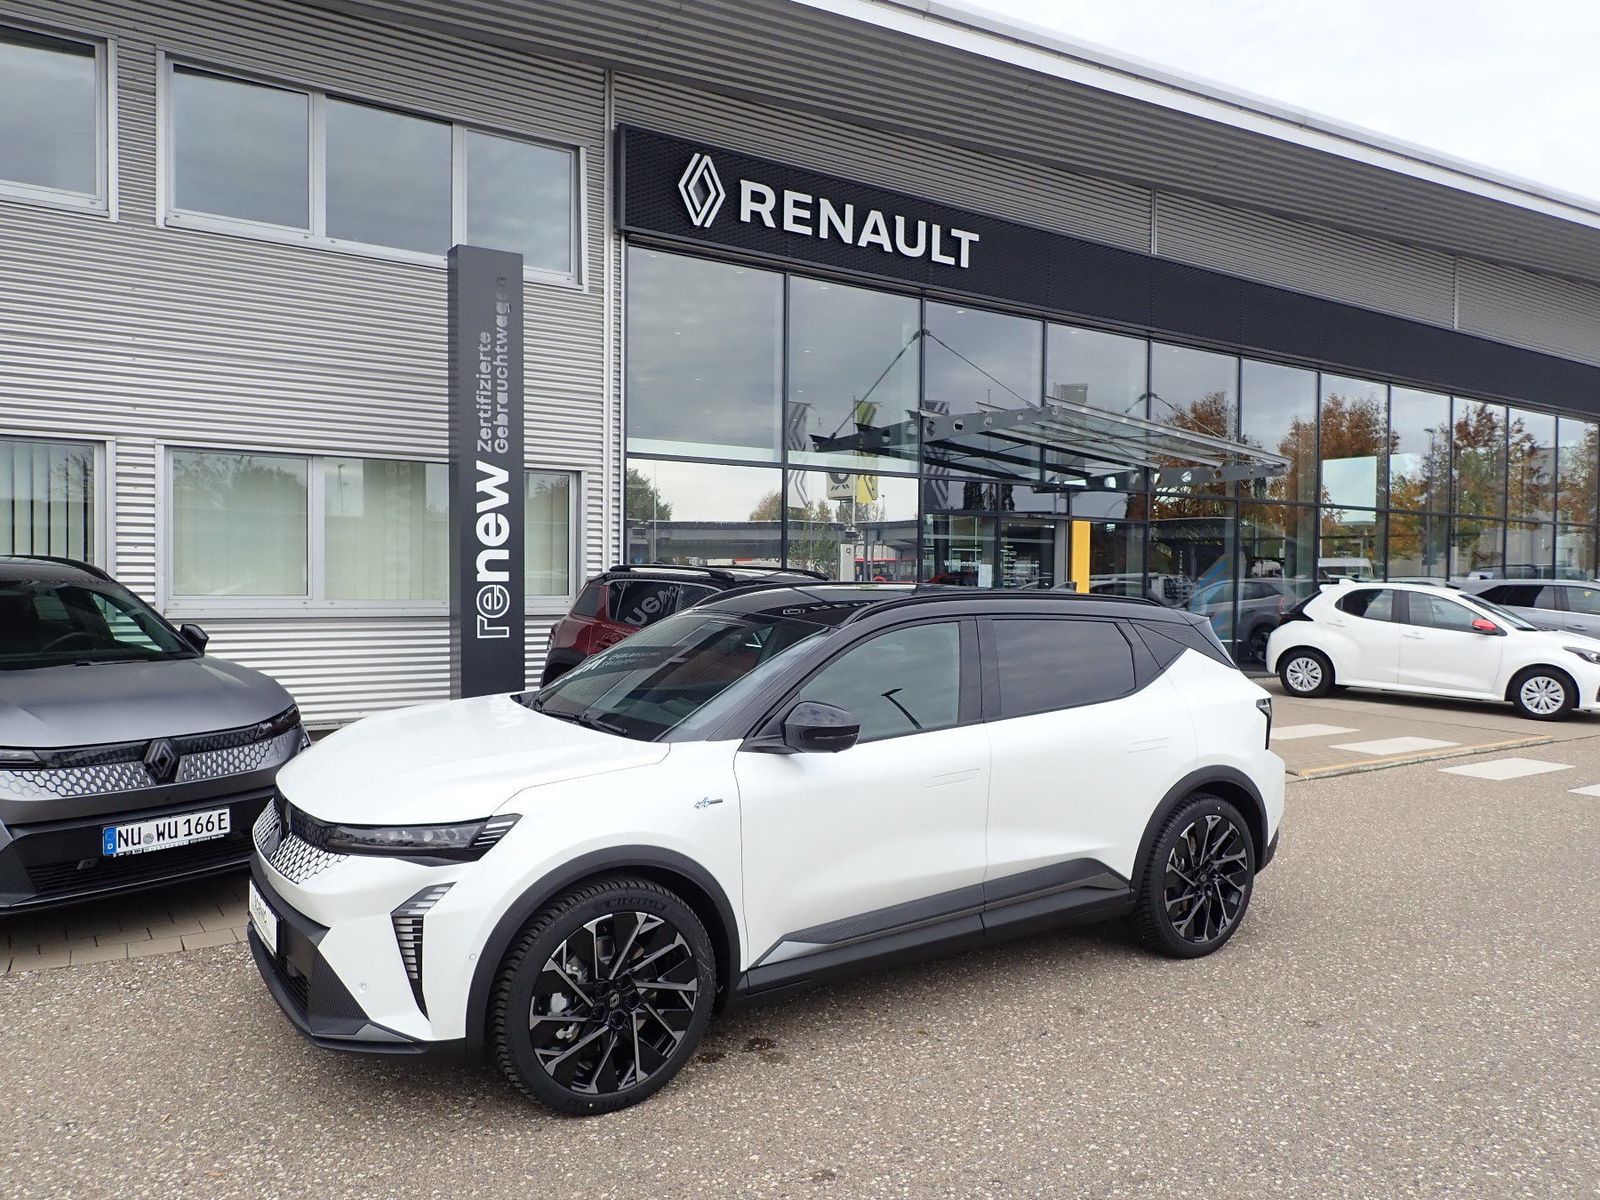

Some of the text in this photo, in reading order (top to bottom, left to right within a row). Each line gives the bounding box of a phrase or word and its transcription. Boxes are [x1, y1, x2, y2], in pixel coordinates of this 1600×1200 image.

[739, 179, 980, 268] RENAULT
[475, 331, 492, 453] Zertifizierte
[475, 460, 510, 639] renew
[117, 827, 142, 849] NU
[155, 820, 178, 842] WU
[183, 812, 228, 837] 166E
